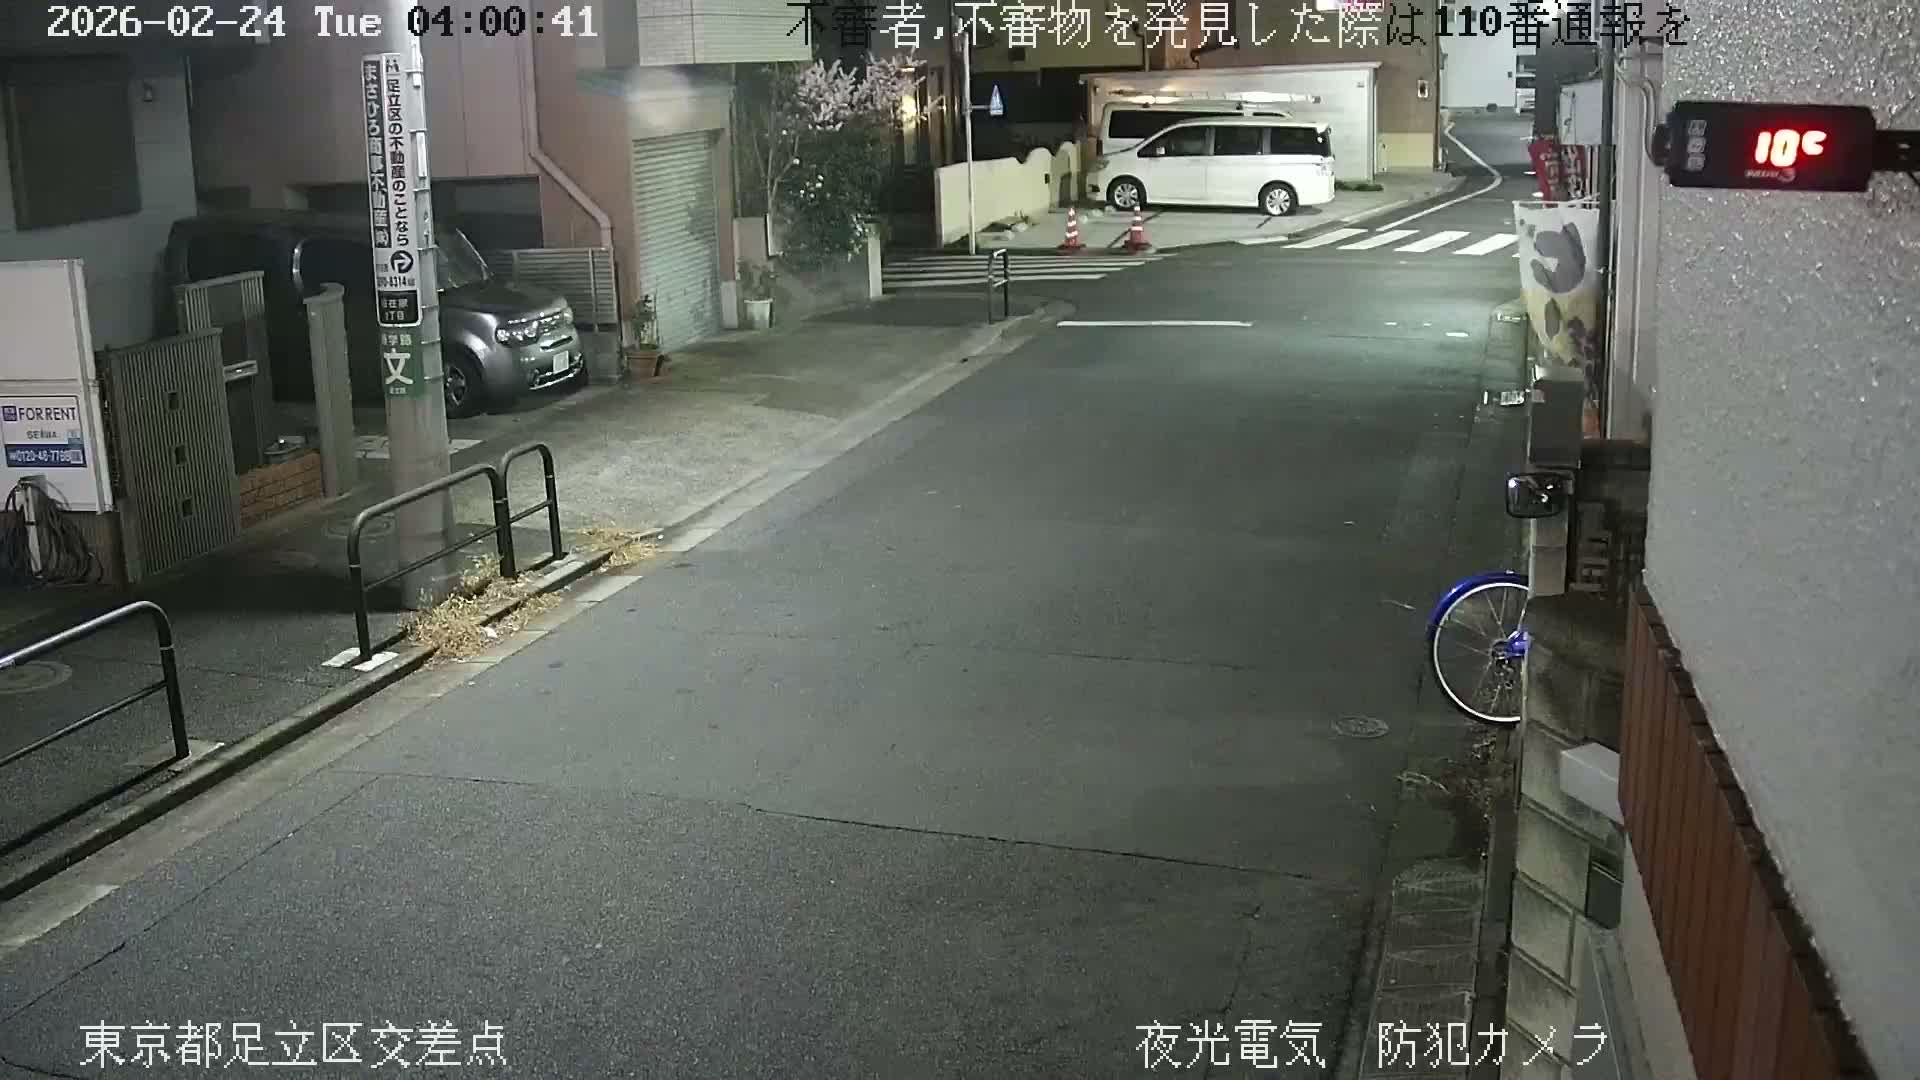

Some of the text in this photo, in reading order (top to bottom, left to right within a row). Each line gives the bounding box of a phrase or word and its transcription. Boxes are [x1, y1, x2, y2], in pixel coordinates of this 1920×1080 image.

[386, 79, 409, 246] 足立区の不動産のことなら
[384, 348, 414, 385] 文
[18, 407, 44, 421] FOR
[45, 407, 76, 421] RENT
